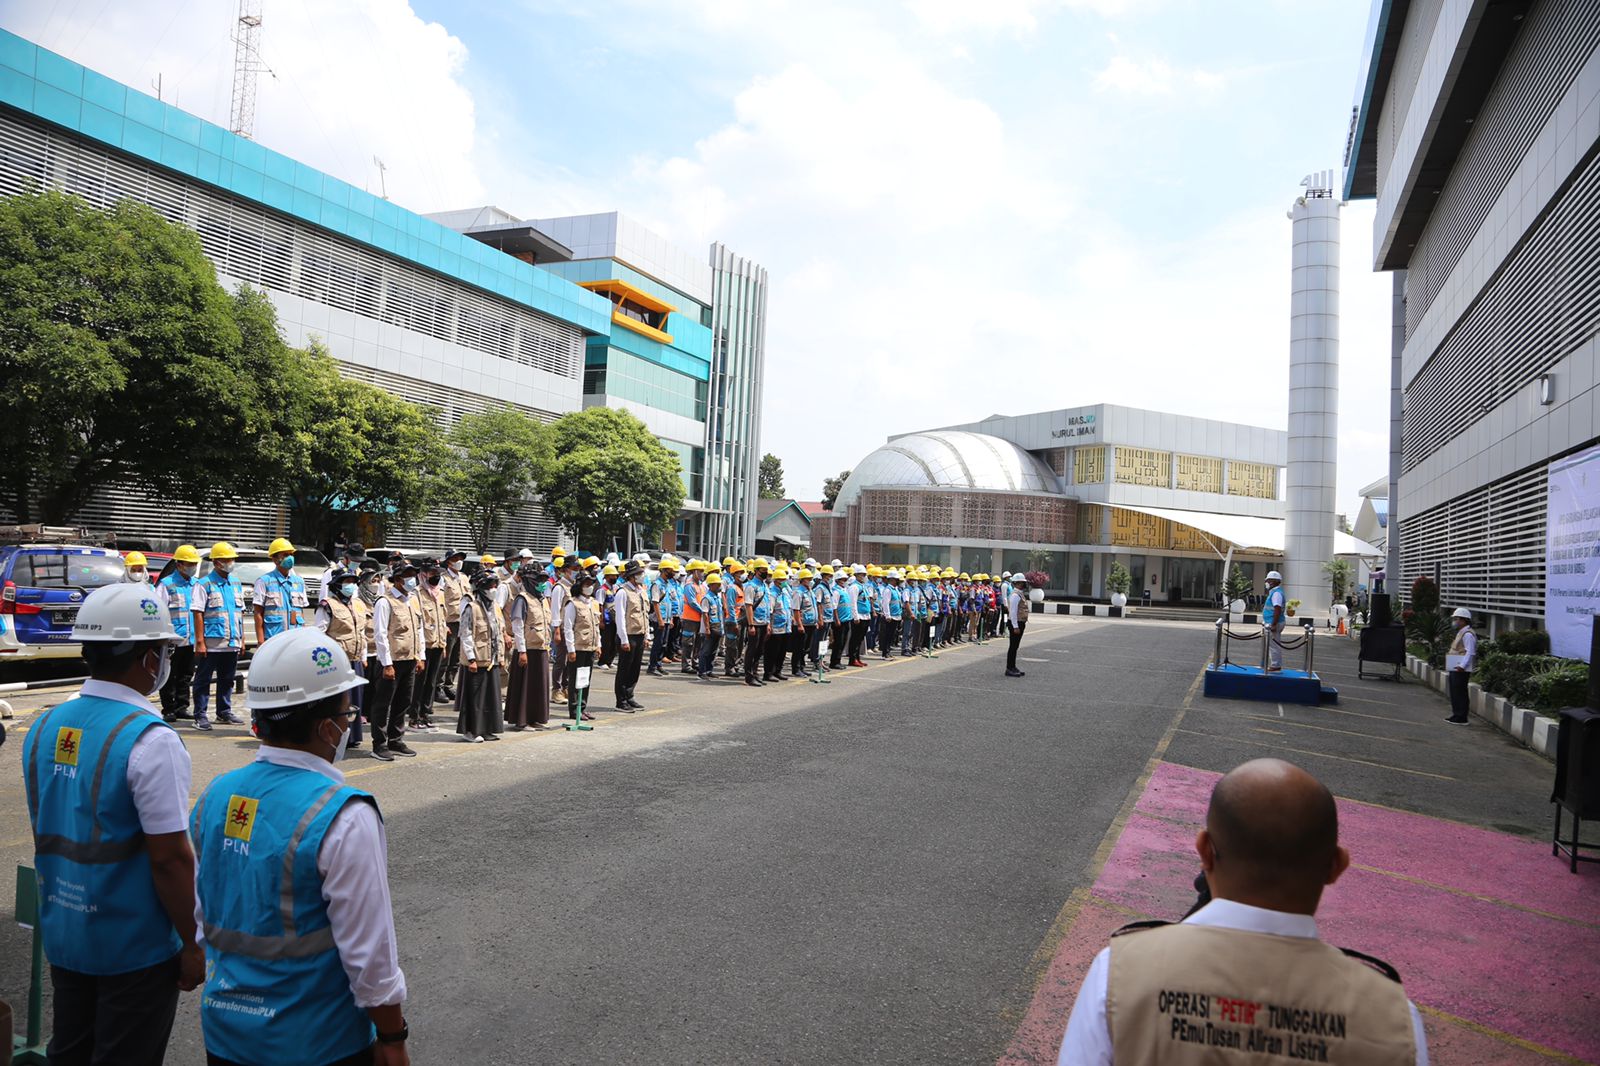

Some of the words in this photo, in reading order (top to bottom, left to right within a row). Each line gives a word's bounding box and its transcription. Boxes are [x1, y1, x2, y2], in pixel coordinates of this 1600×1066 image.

[1052, 428, 1075, 438] NURUL
[1077, 426, 1096, 436] IMAN
[266, 684, 290, 693] TALENTA
[53, 763, 77, 779] PLN
[223, 838, 249, 856] PLN
[207, 998, 277, 1018] TransformasiPLN
[1158, 989, 1211, 1019] OPERASI
[1268, 1004, 1347, 1039] TUNGGAKAN
[1246, 1028, 1283, 1056] Aliran
[1288, 1034, 1329, 1063] Listrik
